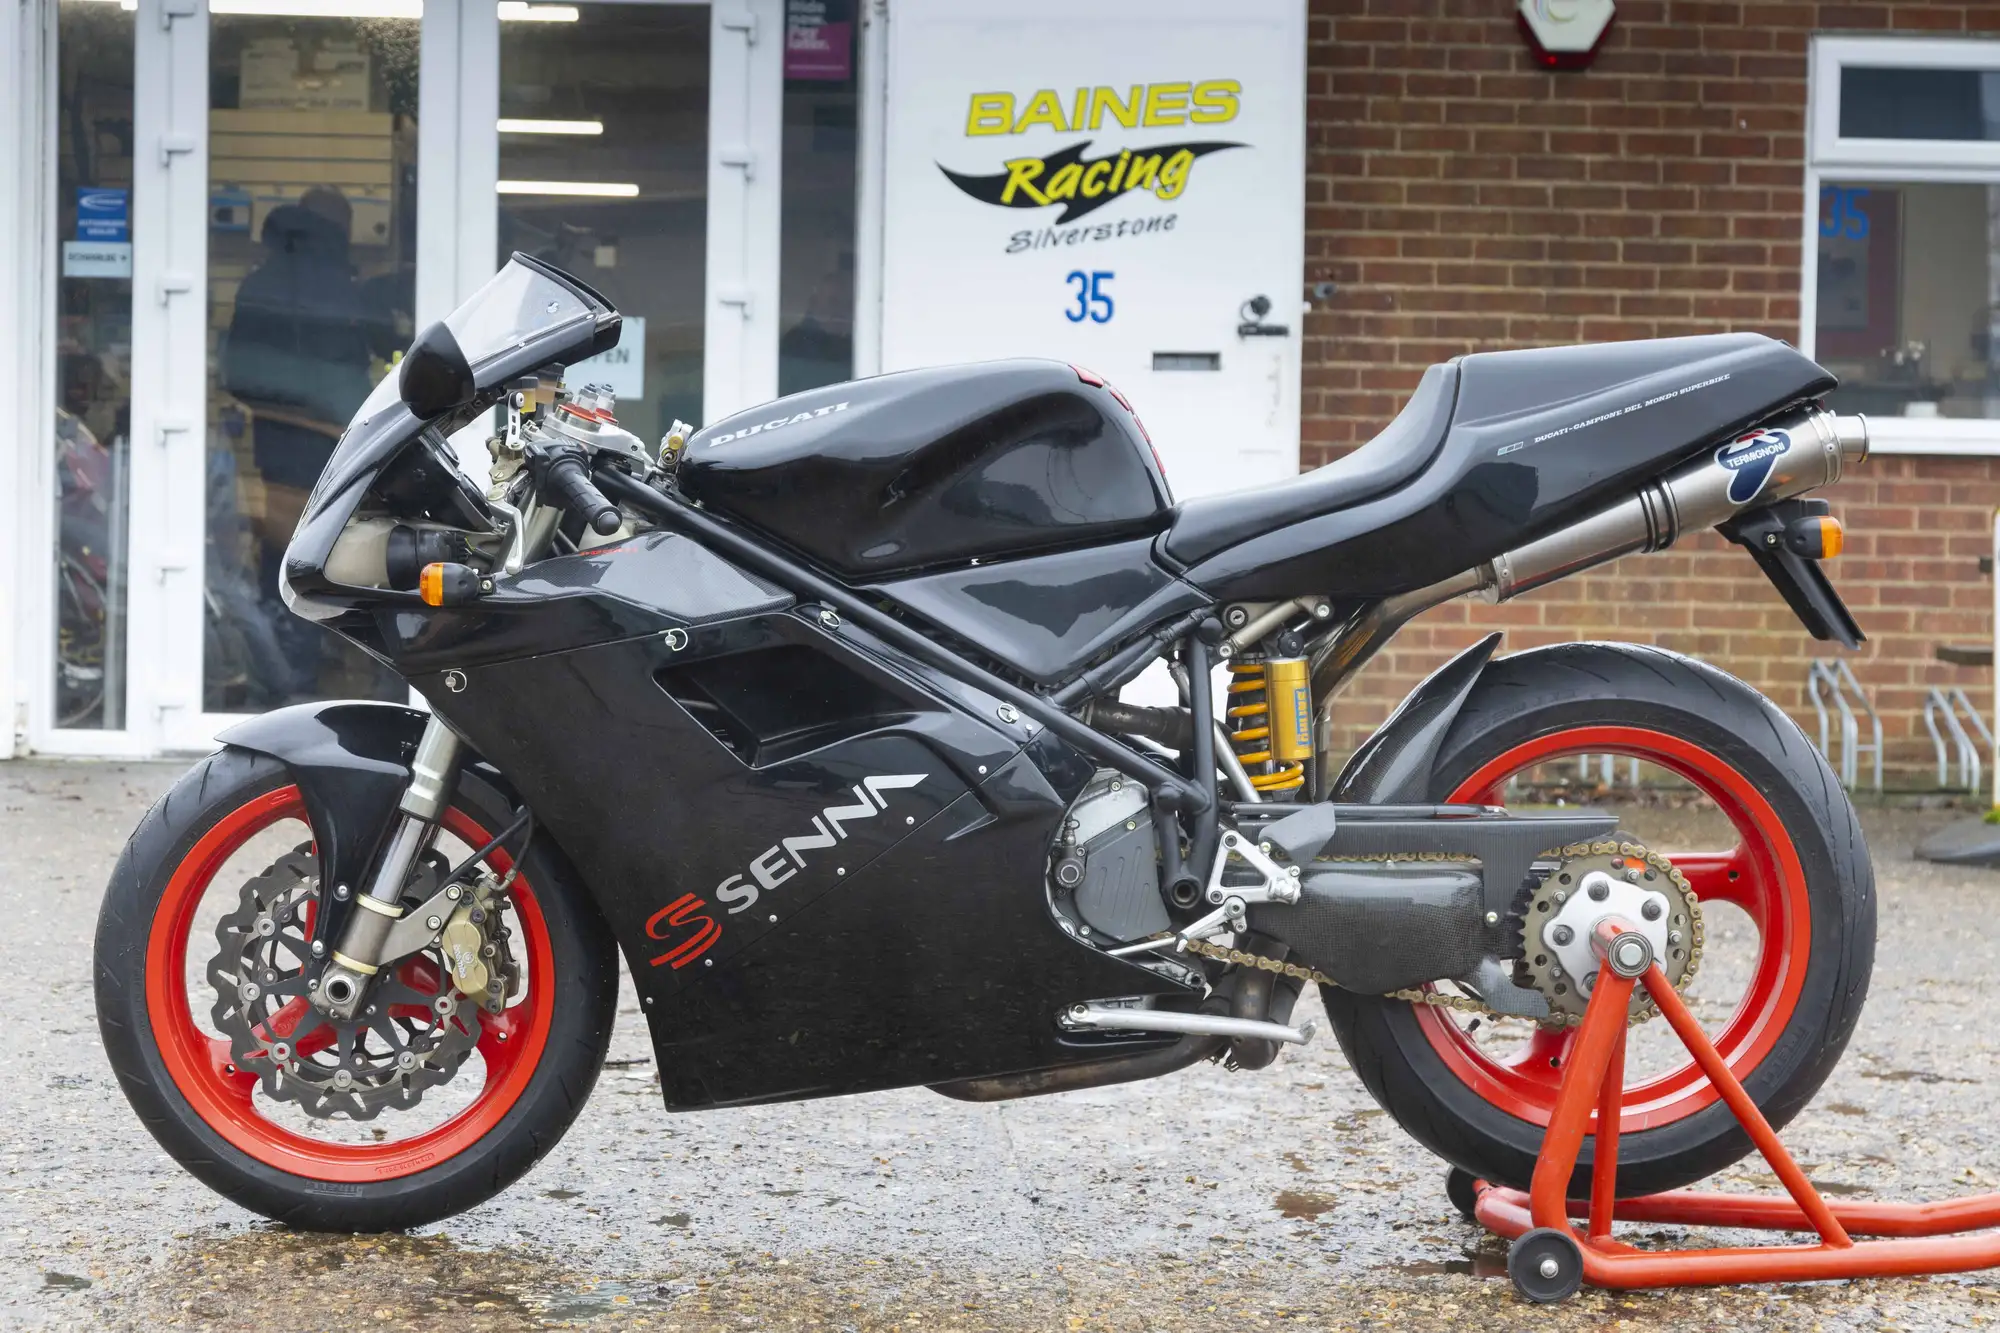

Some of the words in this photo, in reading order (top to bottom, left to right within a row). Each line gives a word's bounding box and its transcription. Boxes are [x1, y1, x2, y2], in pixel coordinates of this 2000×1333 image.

[965, 79, 1242, 136] BAINES
[1000, 148, 1195, 206] Racing
[1005, 213, 1178, 254] Silverstone
[1819, 185, 1870, 240] 35
[1064, 270, 1115, 323] 35
[709, 401, 850, 448] DUCATI
[1534, 409, 1623, 443] DUCATI-CAMPIONE
[1624, 403, 1643, 414] DEL
[1645, 391, 1679, 407] MONDO
[1679, 373, 1731, 395] SUPERBIKE
[1726, 441, 1786, 469] TERMIGNONI
[715, 773, 930, 915] SENNA
